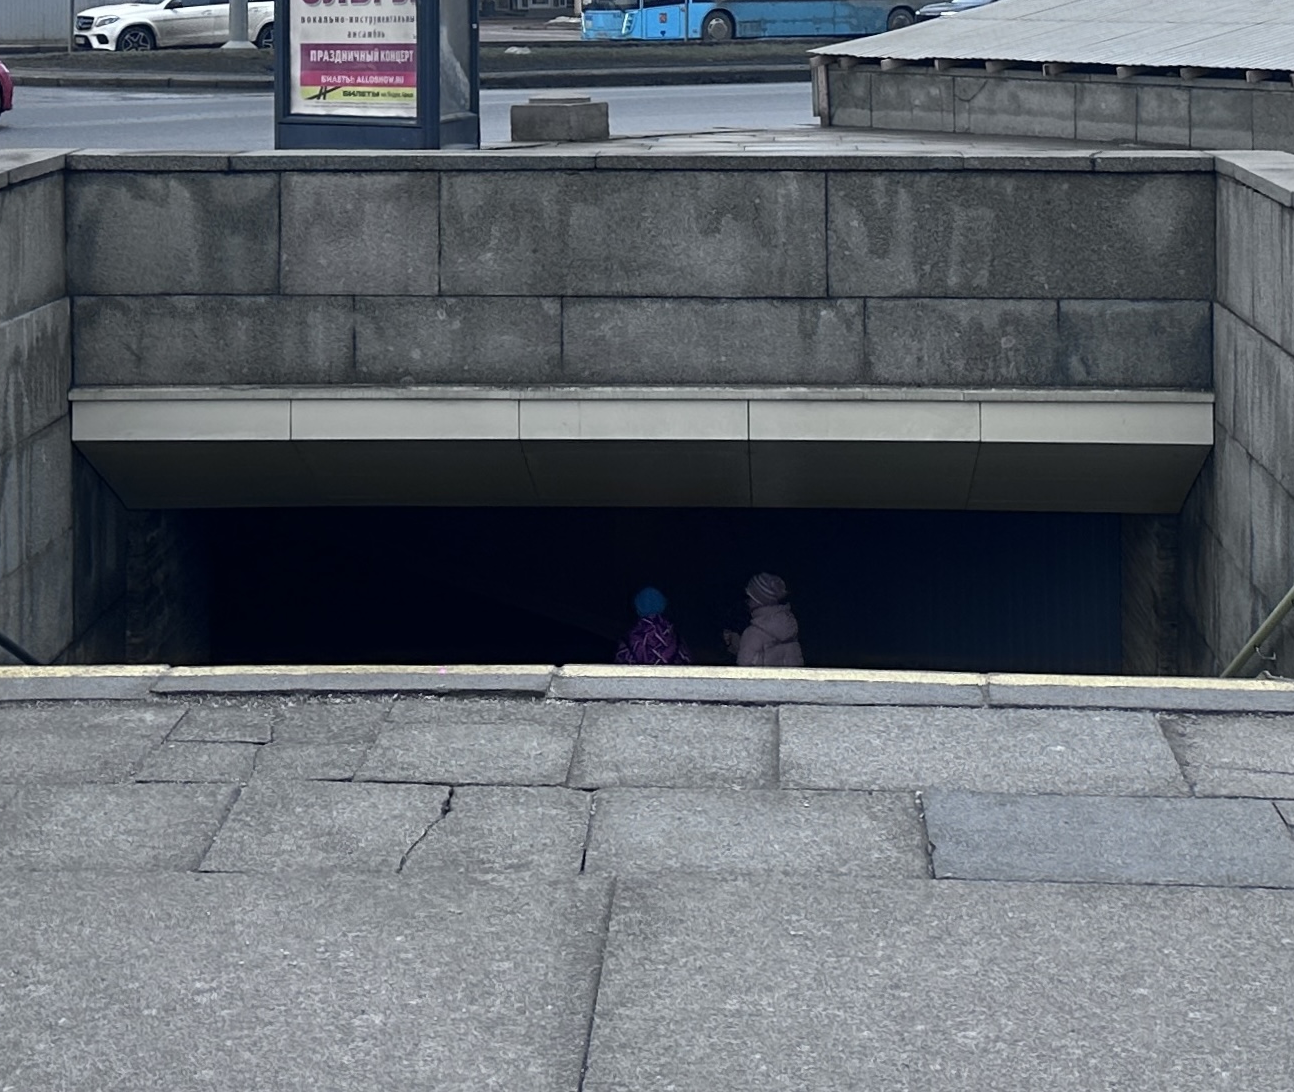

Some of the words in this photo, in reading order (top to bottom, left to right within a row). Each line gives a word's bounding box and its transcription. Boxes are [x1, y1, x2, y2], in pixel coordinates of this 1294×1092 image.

[347, 30, 385, 39] ансамбль
[310, 48, 379, 64] ПРАЗДНИЧНЫЙ
[380, 50, 414, 64] КОНЦЕРТ
[342, 90, 380, 98] БИЛЕТЫ
